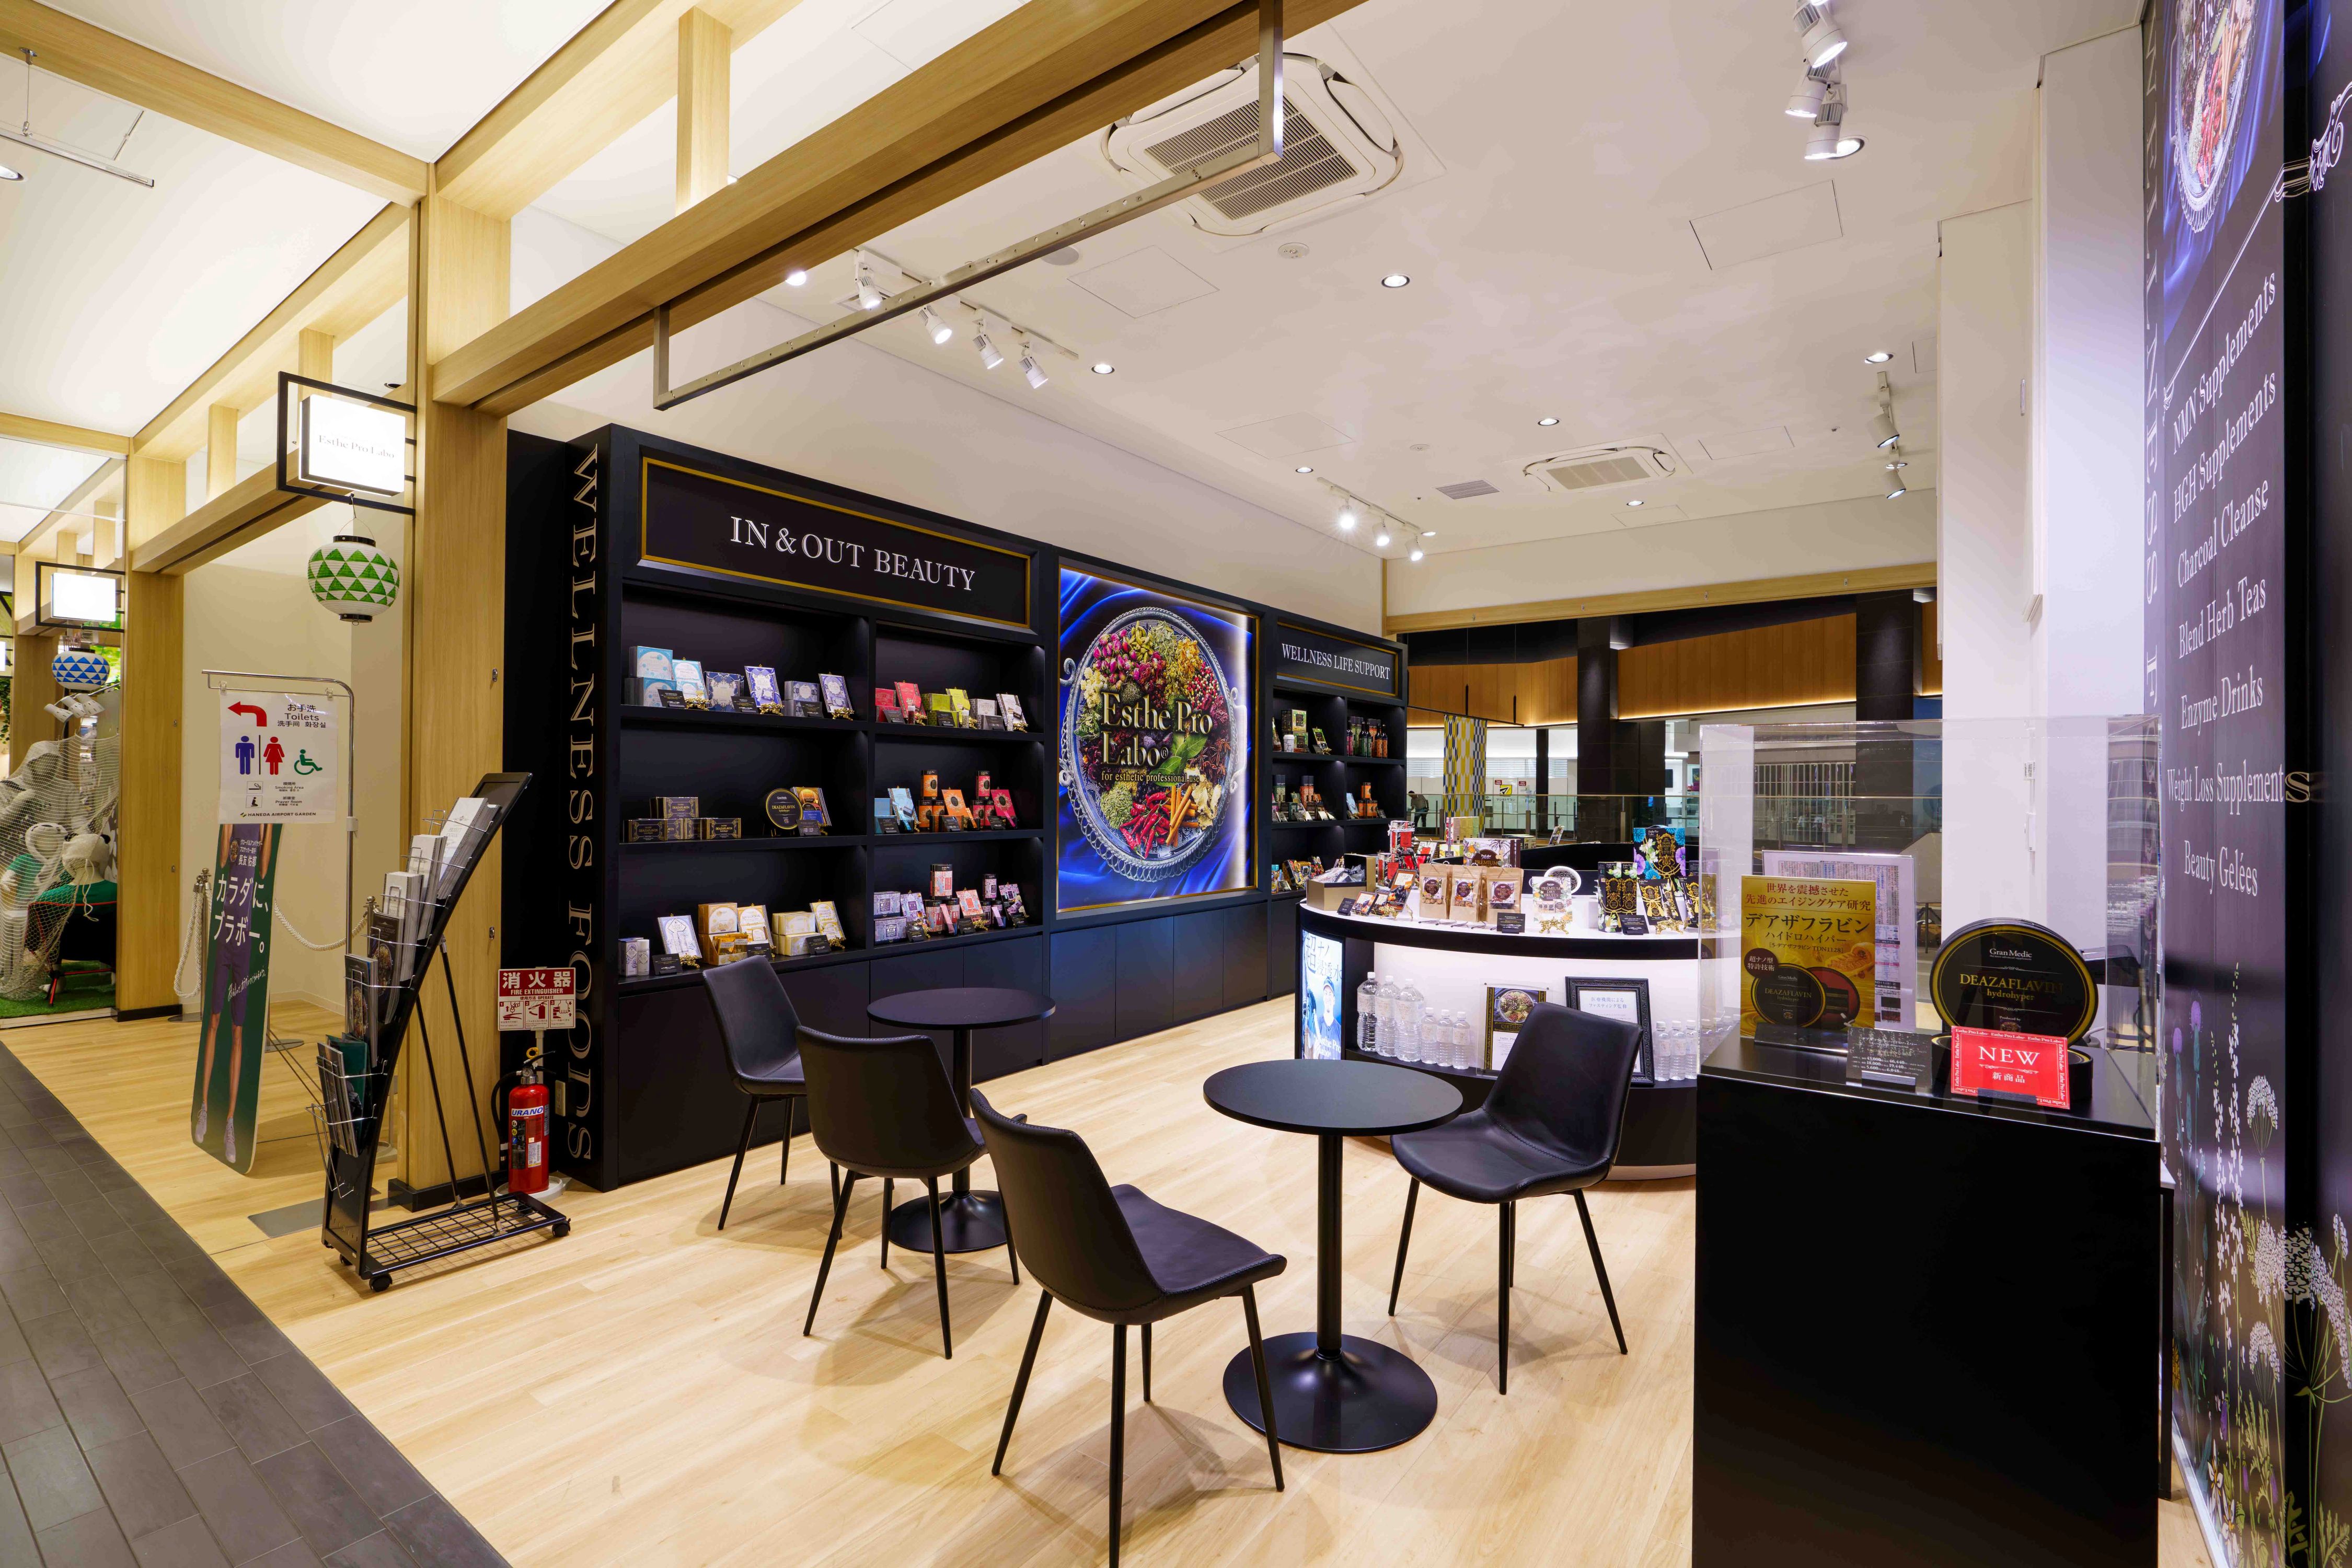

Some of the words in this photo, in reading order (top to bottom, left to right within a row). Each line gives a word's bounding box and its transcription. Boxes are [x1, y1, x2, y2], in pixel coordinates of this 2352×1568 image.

[2174, 388, 2196, 455] NMN
[2200, 272, 2275, 414] Supplements
[351, 442, 368, 452] Pro
[2174, 463, 2196, 523] HGH
[2200, 373, 2275, 492] Supplements
[2178, 517, 2217, 587] Charcoal
[2221, 480, 2268, 548] Cleanse
[730, 516, 770, 548] IN
[776, 528, 796, 554] &
[802, 534, 864, 568] OUT
[874, 549, 975, 591] BEAUTY
[2179, 609, 2204, 659] Blend
[2207, 589, 2233, 642] Herb
[2238, 577, 2265, 621] Teas
[569, 443, 597, 870] WELLNESS
[1282, 643, 1332, 667] WELLNESS
[1334, 655, 1353, 672] LIFE
[1355, 660, 1390, 679] SUPPORT
[2181, 695, 2217, 736] Enzyme
[2221, 664, 2263, 717] Drinks
[1101, 691, 1171, 730] Esthe
[1176, 701, 1213, 734] Pro
[1101, 771, 1112, 780] for
[1115, 773, 1143, 781] esthetic
[1146, 773, 1187, 784] professional
[2167, 767, 2192, 811] Weight
[2195, 766, 2213, 802] Loss
[2217, 759, 2310, 815] Supplements
[238, 855, 247, 866] 長友
[2184, 840, 2215, 894] Beauty
[2219, 847, 2257, 896] Gelées
[216, 874, 269, 912] カラダに、
[1766, 883, 1849, 897] 世界を震撼させた
[1745, 894, 1871, 911] 先進のエイジングケア研究
[214, 910, 264, 953] ブラボー。
[1745, 913, 1870, 934] デアザフラビン
[1765, 931, 1847, 943] ハイドロハイパー
[1747, 963, 1774, 972] 特許技術
[502, 971, 571, 989] 消火器
[1960, 974, 2064, 994] DEAZAFLAVIN
[1765, 988, 1812, 998] DEAZAFLAVIN
[1987, 988, 2035, 1002] hydrohyper
[567, 900, 592, 1160] FOODS
[1978, 1046, 2040, 1066] NEW
[1992, 1072, 2025, 1083] 新商品
[512, 1107, 543, 1115] URANO
